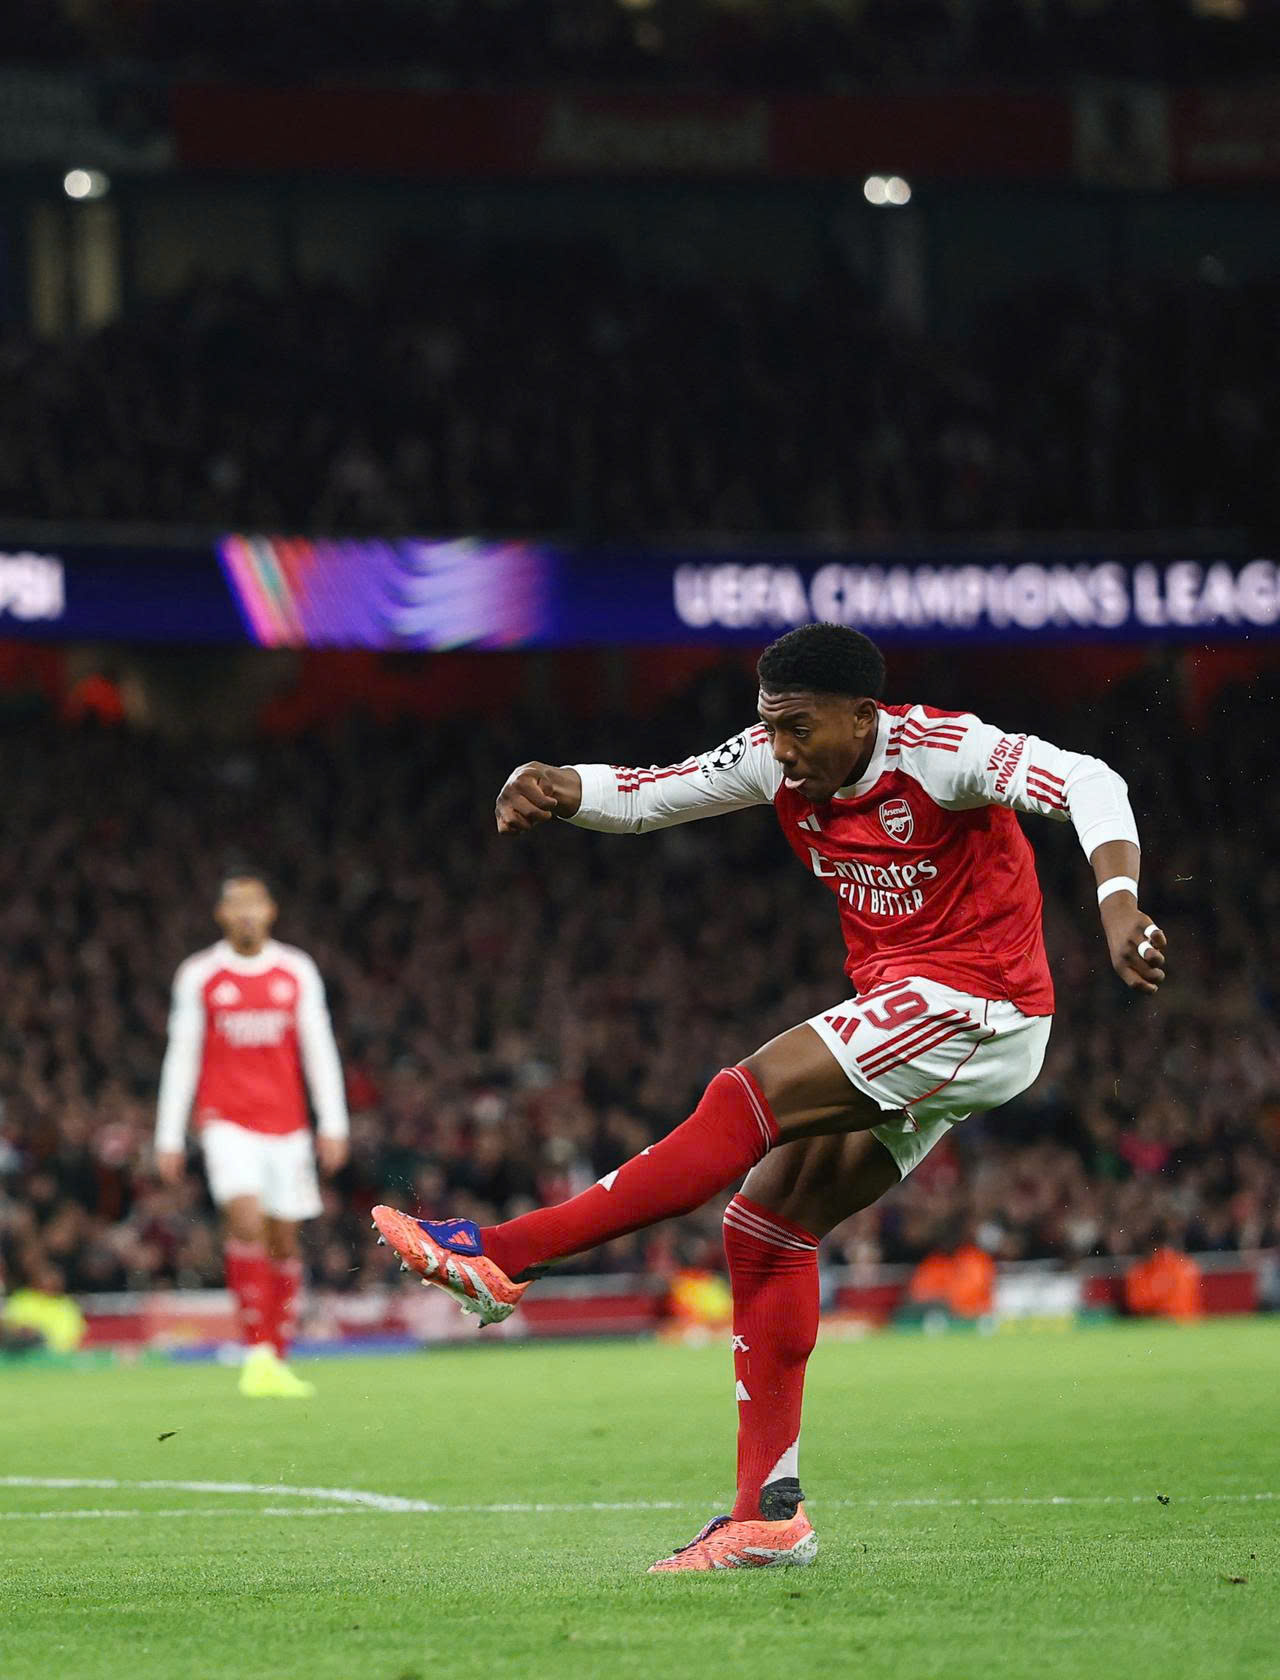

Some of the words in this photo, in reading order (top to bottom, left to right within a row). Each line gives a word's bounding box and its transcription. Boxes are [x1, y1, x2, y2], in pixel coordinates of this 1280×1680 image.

[675, 561, 807, 628] UEFA
[810, 561, 1130, 628] CHAMPIONS
[1133, 560, 1280, 628] LEAG
[986, 737, 1013, 771] VISIT
[807, 846, 938, 890] Emirates
[870, 888, 924, 916] BETTER
